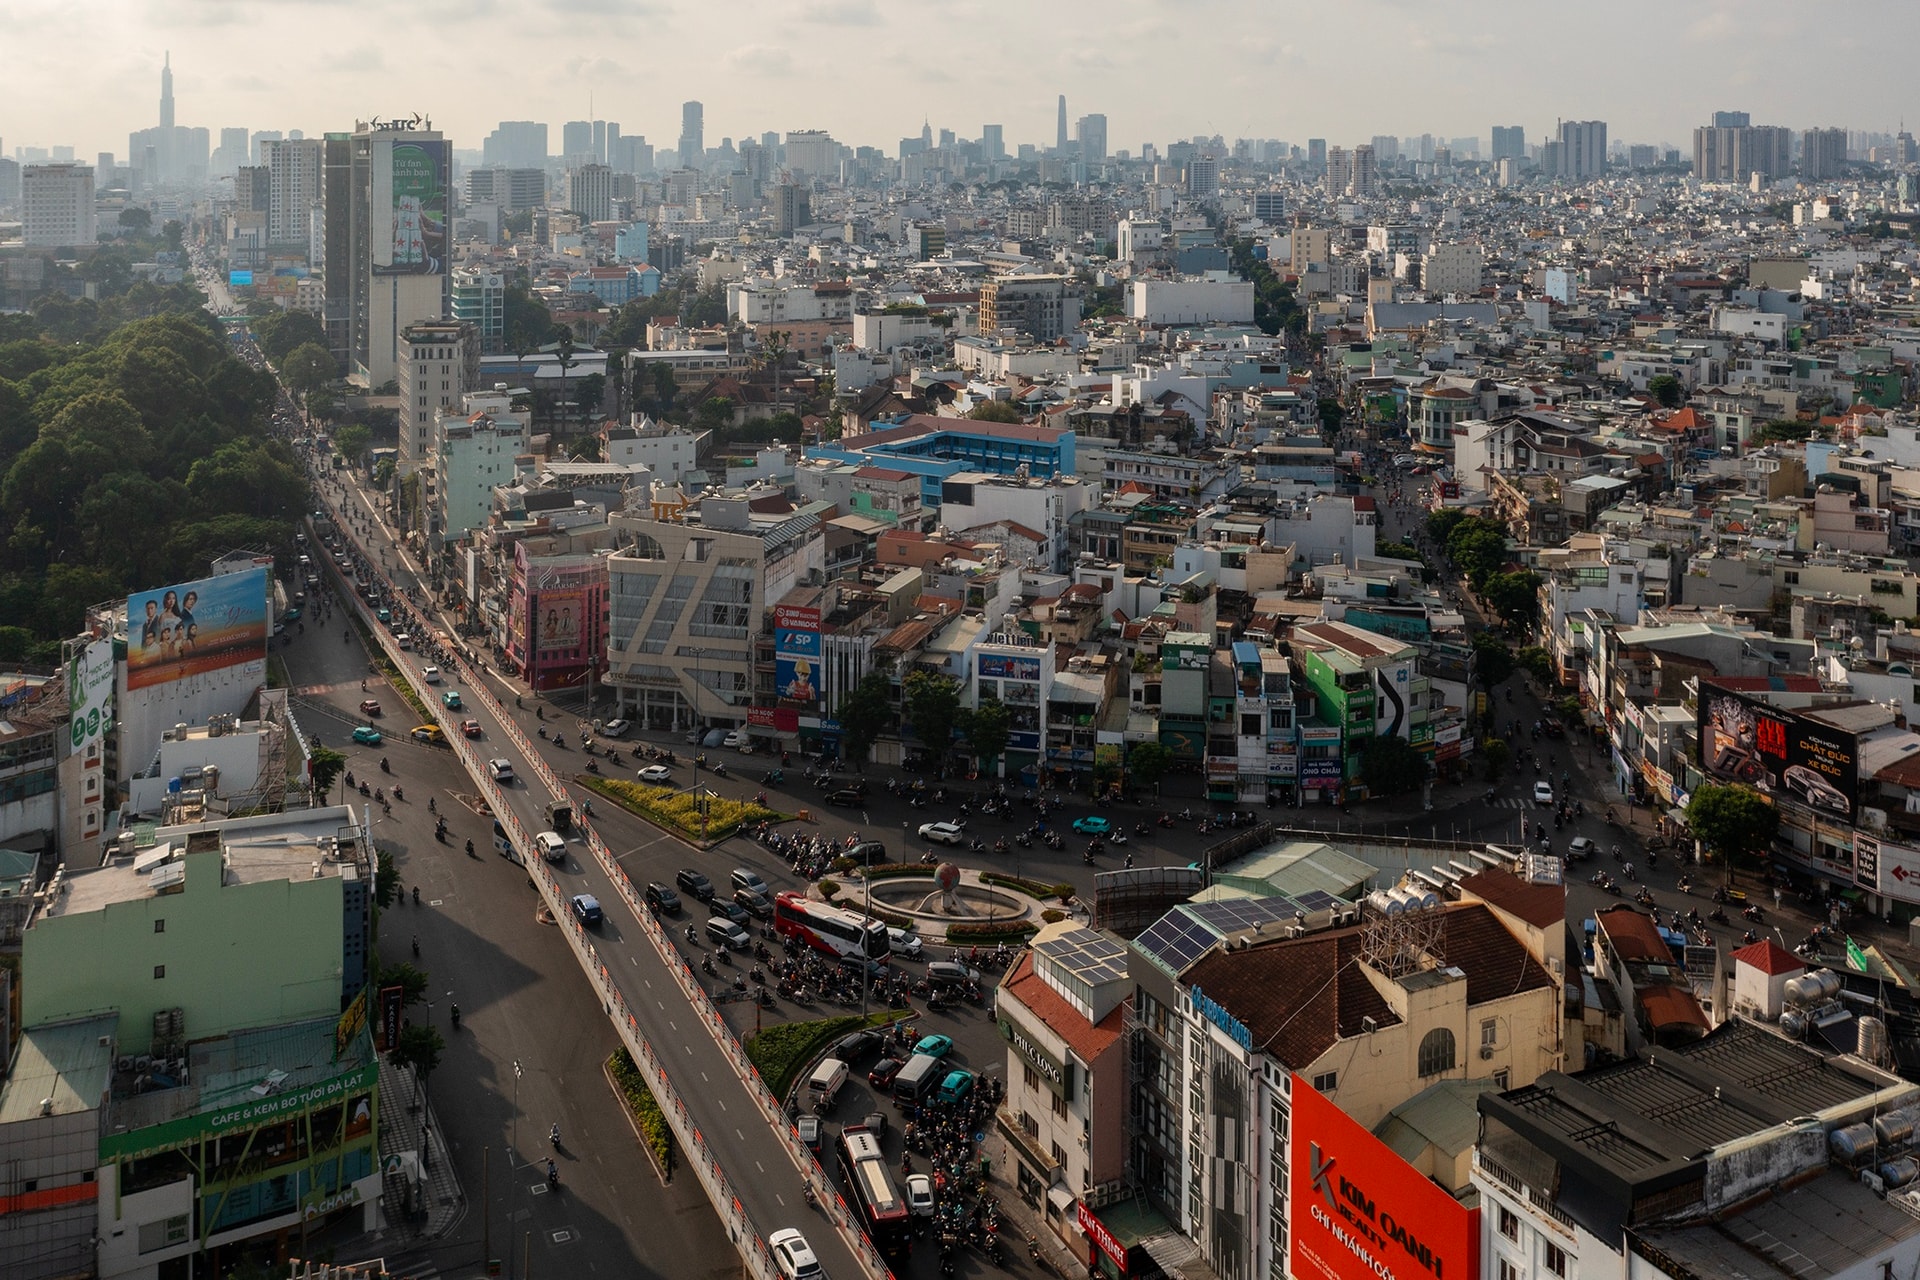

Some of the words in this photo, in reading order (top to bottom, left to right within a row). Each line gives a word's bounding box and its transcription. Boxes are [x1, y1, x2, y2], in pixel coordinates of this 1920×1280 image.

[651, 502, 684, 521] TTC
[388, 1004, 396, 1047] KARAOKE
[1036, 1053, 1060, 1083] LONG
[211, 1111, 241, 1126] CAFE
[243, 1109, 251, 1118] &
[254, 1102, 279, 1116] KEM
[281, 1095, 298, 1109] BƠ
[299, 1087, 325, 1104] TƯƠI
[327, 1082, 343, 1094] ĐÀ
[344, 1073, 364, 1088] LẠT
[1311, 1204, 1330, 1230] CHI
[1332, 1222, 1374, 1269] NHÁNH
[1340, 1202, 1387, 1251] REALTY
[1340, 1175, 1375, 1223] KIM
[1380, 1212, 1442, 1279] OANH
